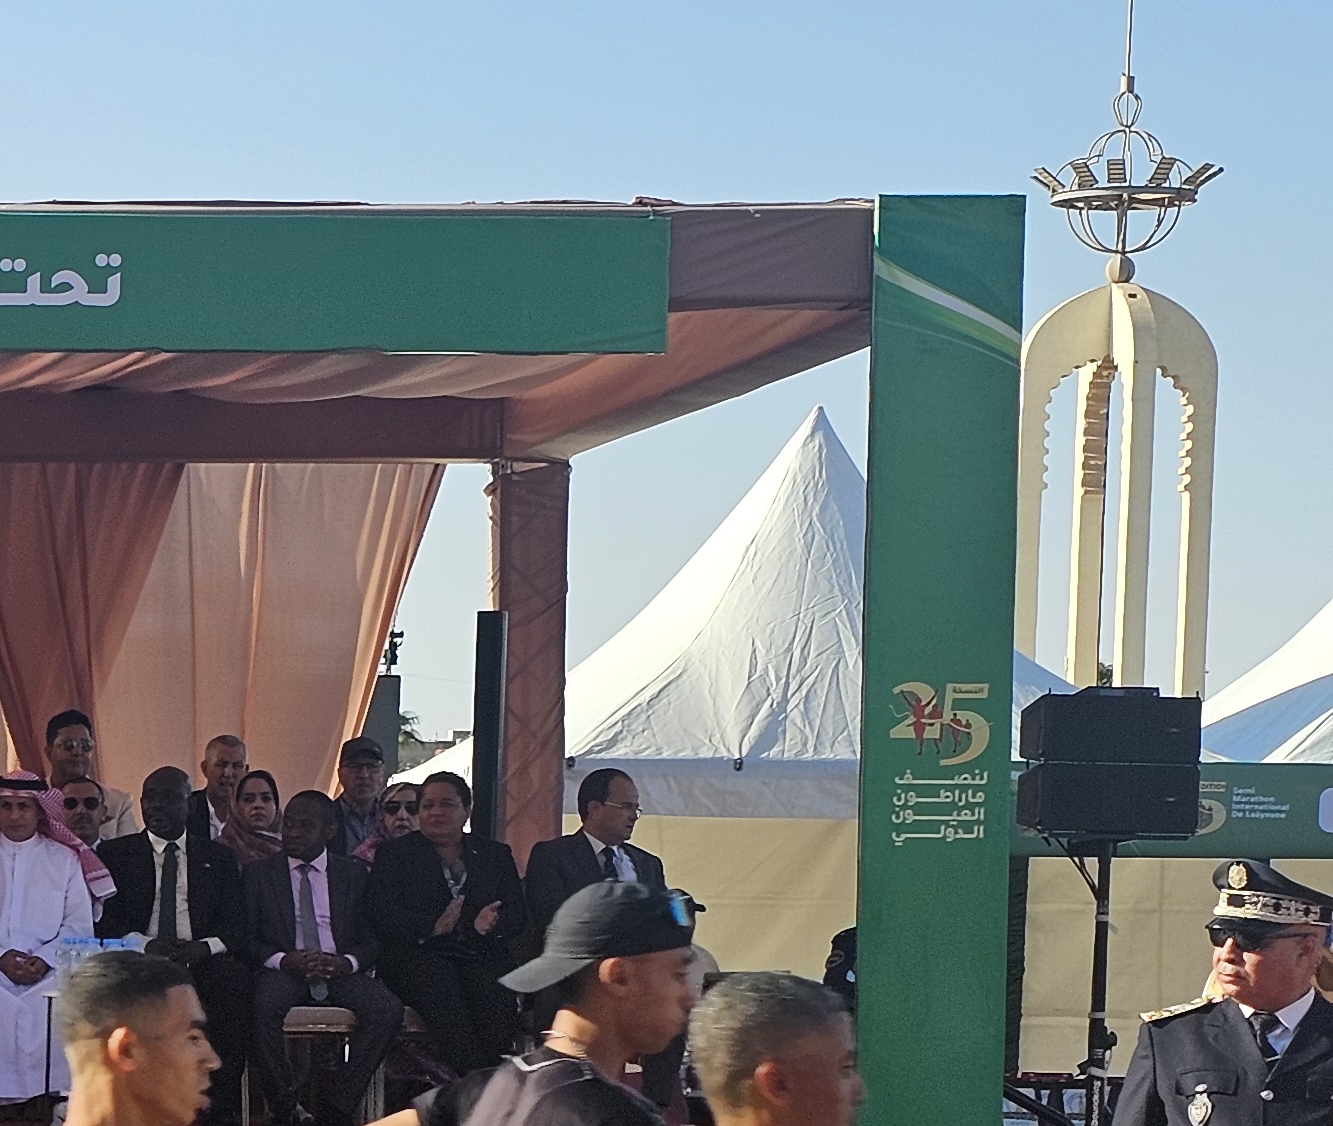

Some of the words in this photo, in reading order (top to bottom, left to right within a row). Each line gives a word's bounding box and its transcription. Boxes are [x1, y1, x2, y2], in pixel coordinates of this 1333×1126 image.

[889, 681, 990, 766] 25
[894, 769, 988, 785] لنصف
[892, 788, 985, 806] ماراطون
[891, 807, 985, 825] العيون
[891, 825, 985, 846] الدولي
